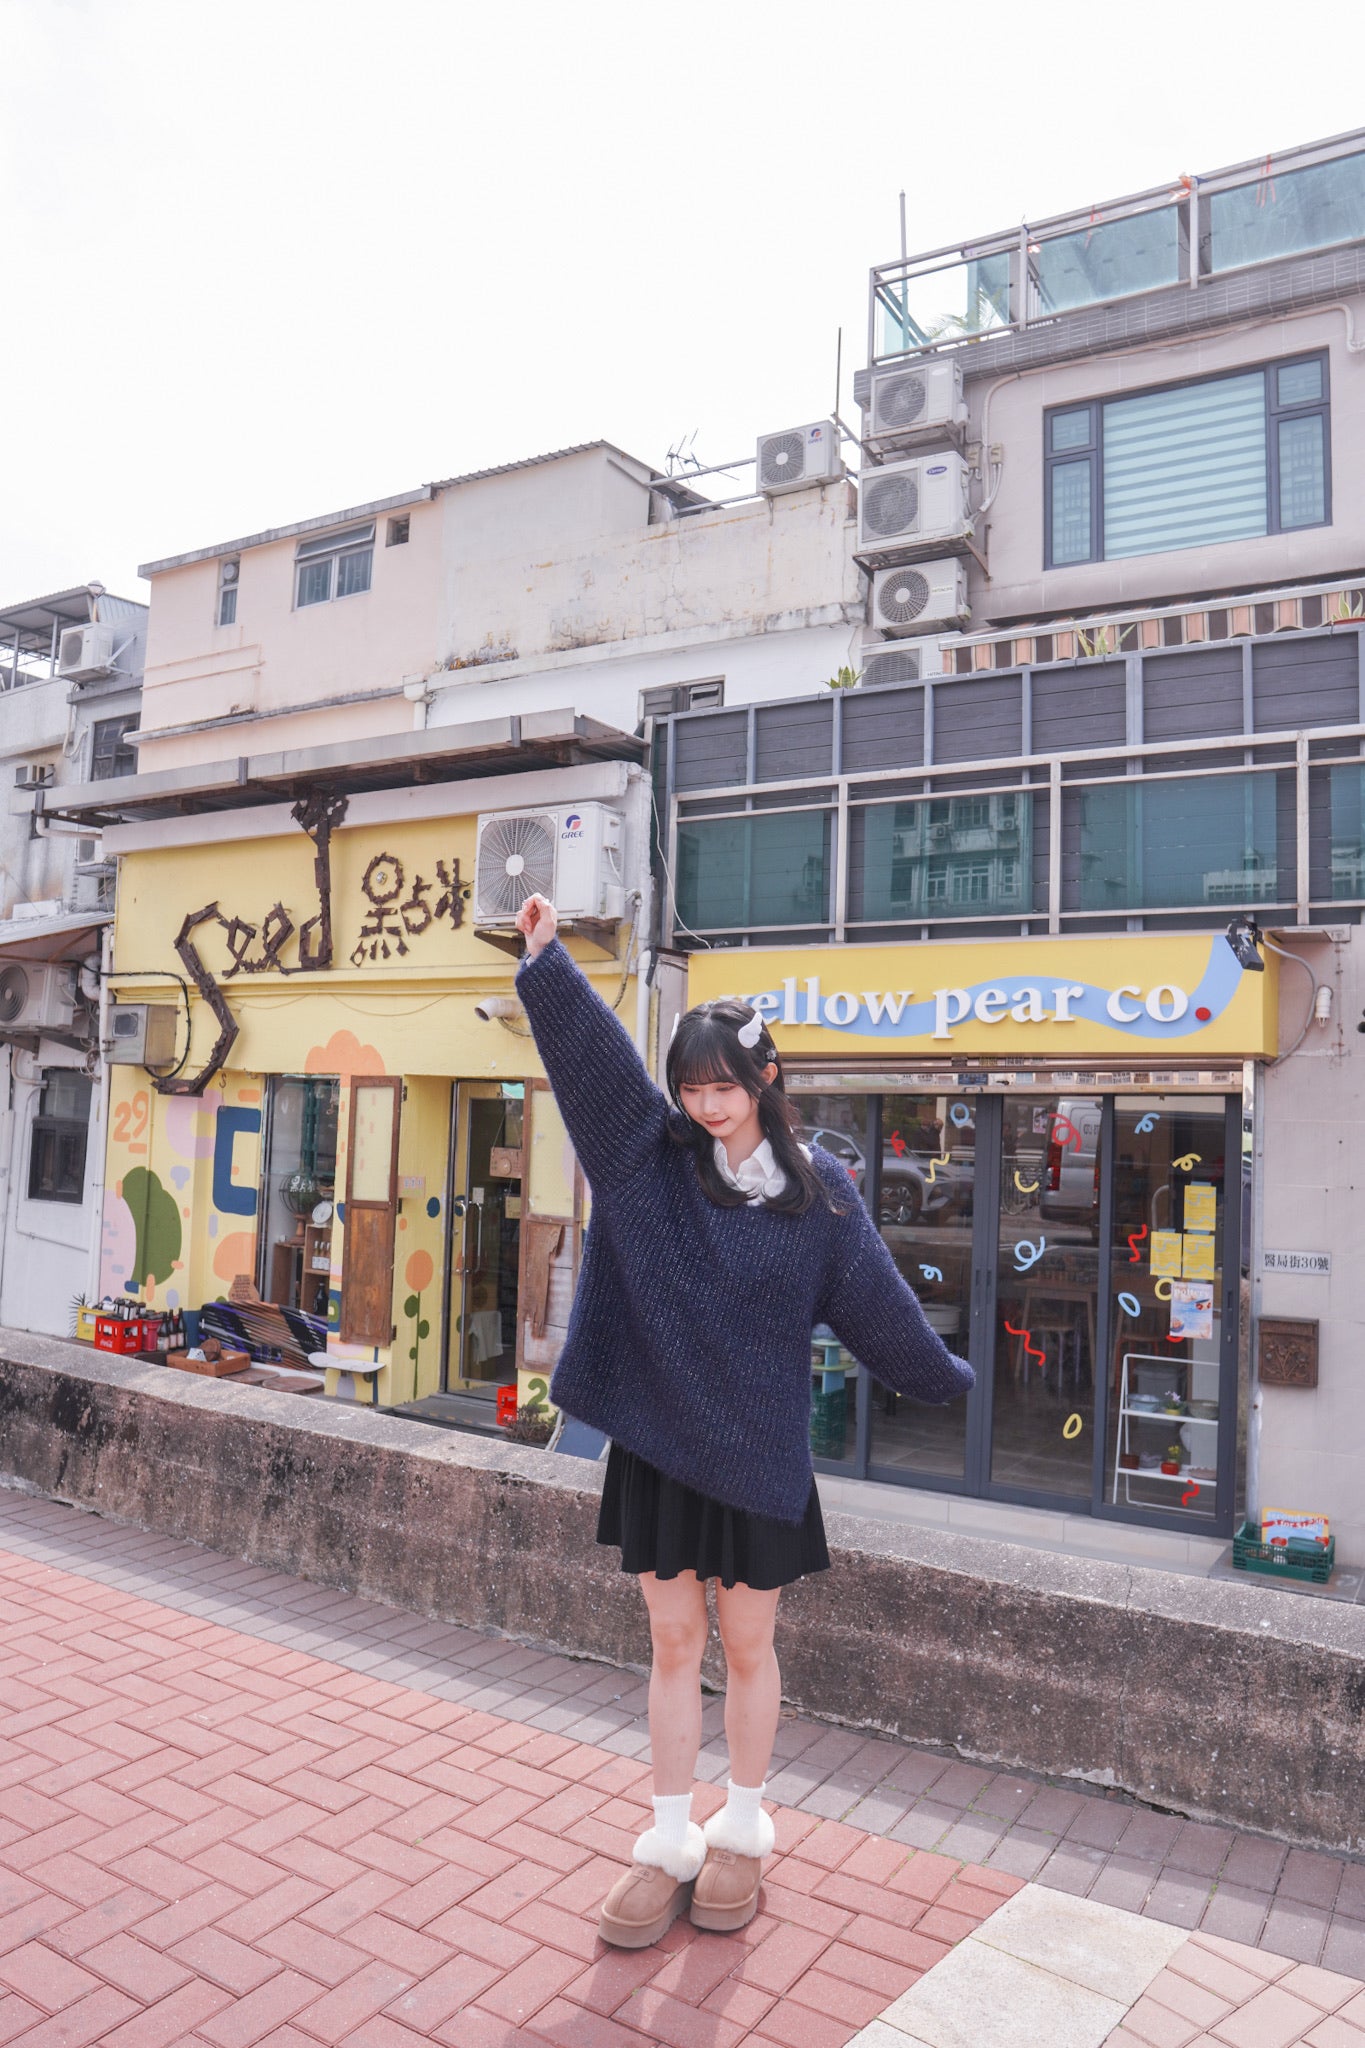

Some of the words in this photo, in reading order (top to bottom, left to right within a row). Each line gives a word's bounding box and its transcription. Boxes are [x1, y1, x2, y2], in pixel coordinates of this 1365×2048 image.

[561, 831, 584, 839] GREE
[151, 790, 350, 1098] Seed
[717, 976, 914, 1026] ellow
[931, 986, 1084, 1040] pear
[1106, 984, 1211, 1024] co.
[113, 1090, 149, 1142] 29
[1264, 1253, 1329, 1271] 醫局街30號
